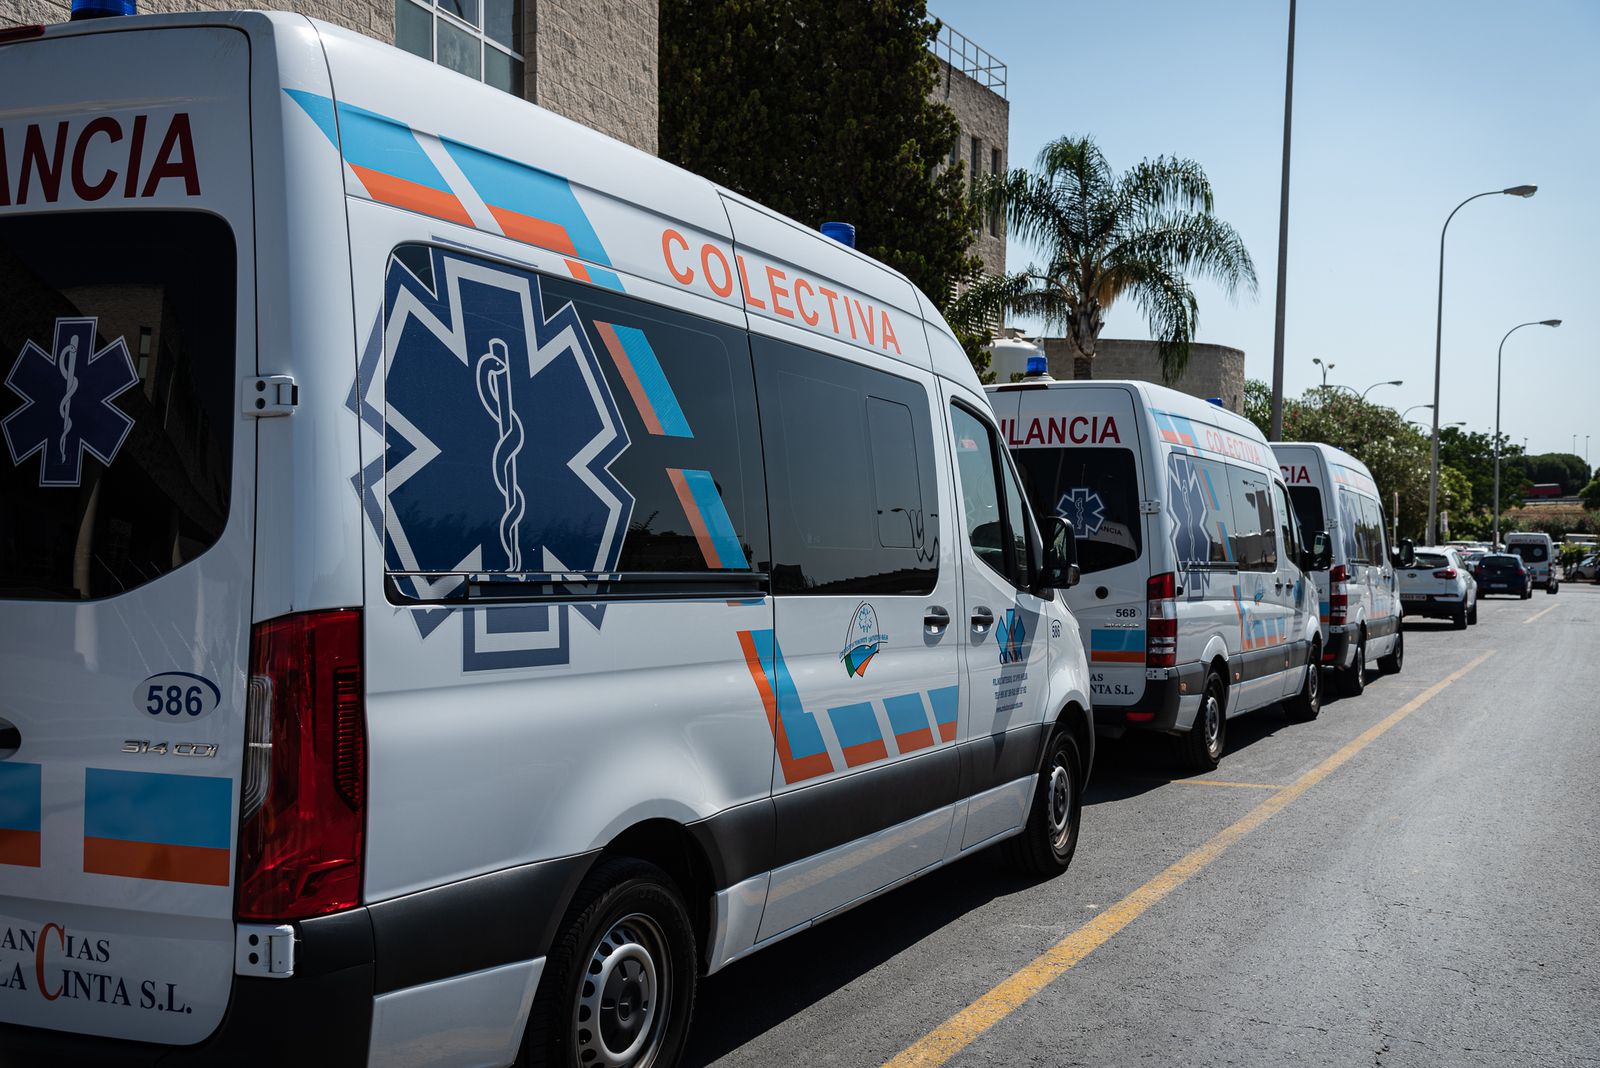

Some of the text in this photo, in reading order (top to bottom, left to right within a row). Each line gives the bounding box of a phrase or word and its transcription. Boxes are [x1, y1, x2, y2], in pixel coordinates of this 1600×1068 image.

[0, 113, 201, 206] NCIA
[661, 228, 902, 355] COLECTIVA
[1205, 430, 1261, 464] COLECTIVA
[1115, 608, 1136, 618] 568
[146, 685, 203, 717] 586
[1114, 684, 1134, 695] S.L.
[121, 740, 220, 759] 314 CDI
[139, 980, 193, 1015] S.L.
